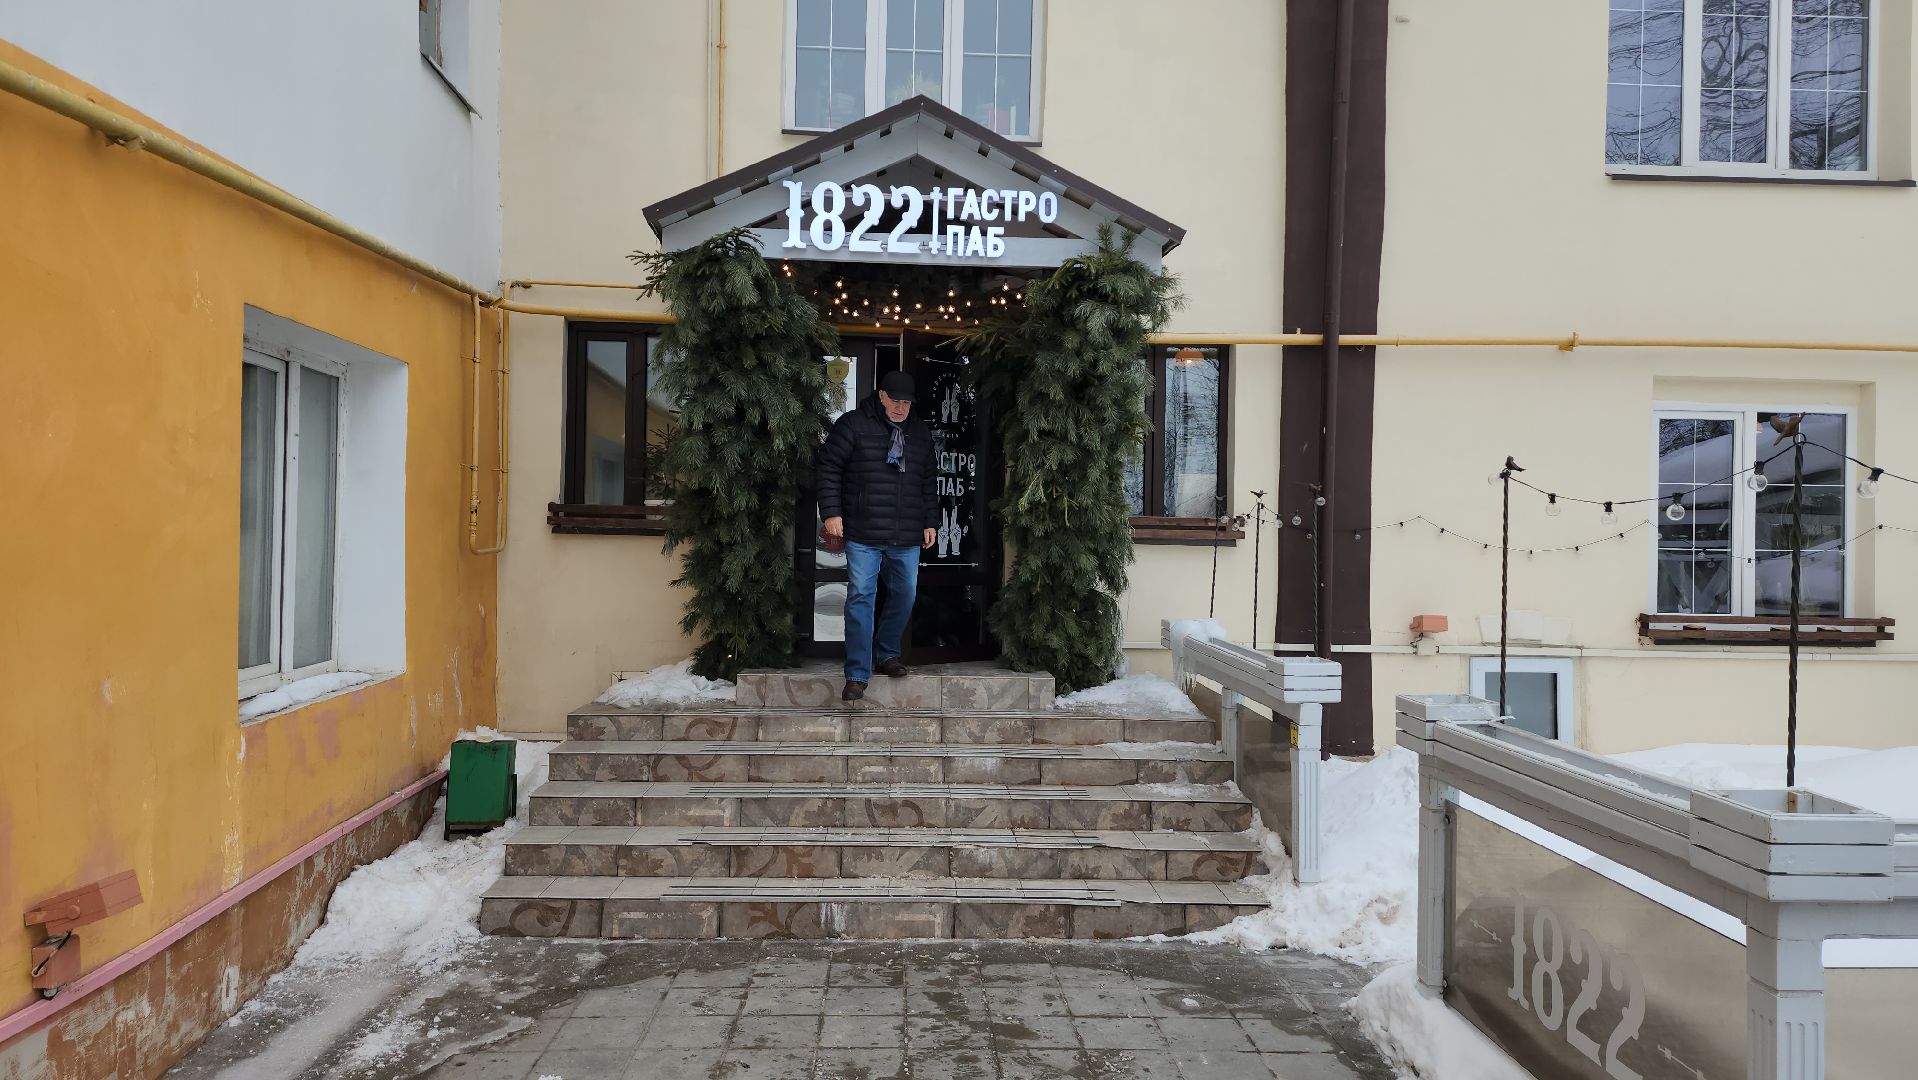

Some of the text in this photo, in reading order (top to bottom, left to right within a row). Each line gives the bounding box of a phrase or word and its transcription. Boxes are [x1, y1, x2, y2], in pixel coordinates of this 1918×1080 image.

[782, 180, 923, 254] 1822
[946, 187, 1058, 223] ГАСТРО
[946, 225, 1005, 258] ПАБ
[935, 450, 976, 473] СТРО
[937, 476, 965, 496] ПАБ
[1507, 892, 1647, 1079] 1822
